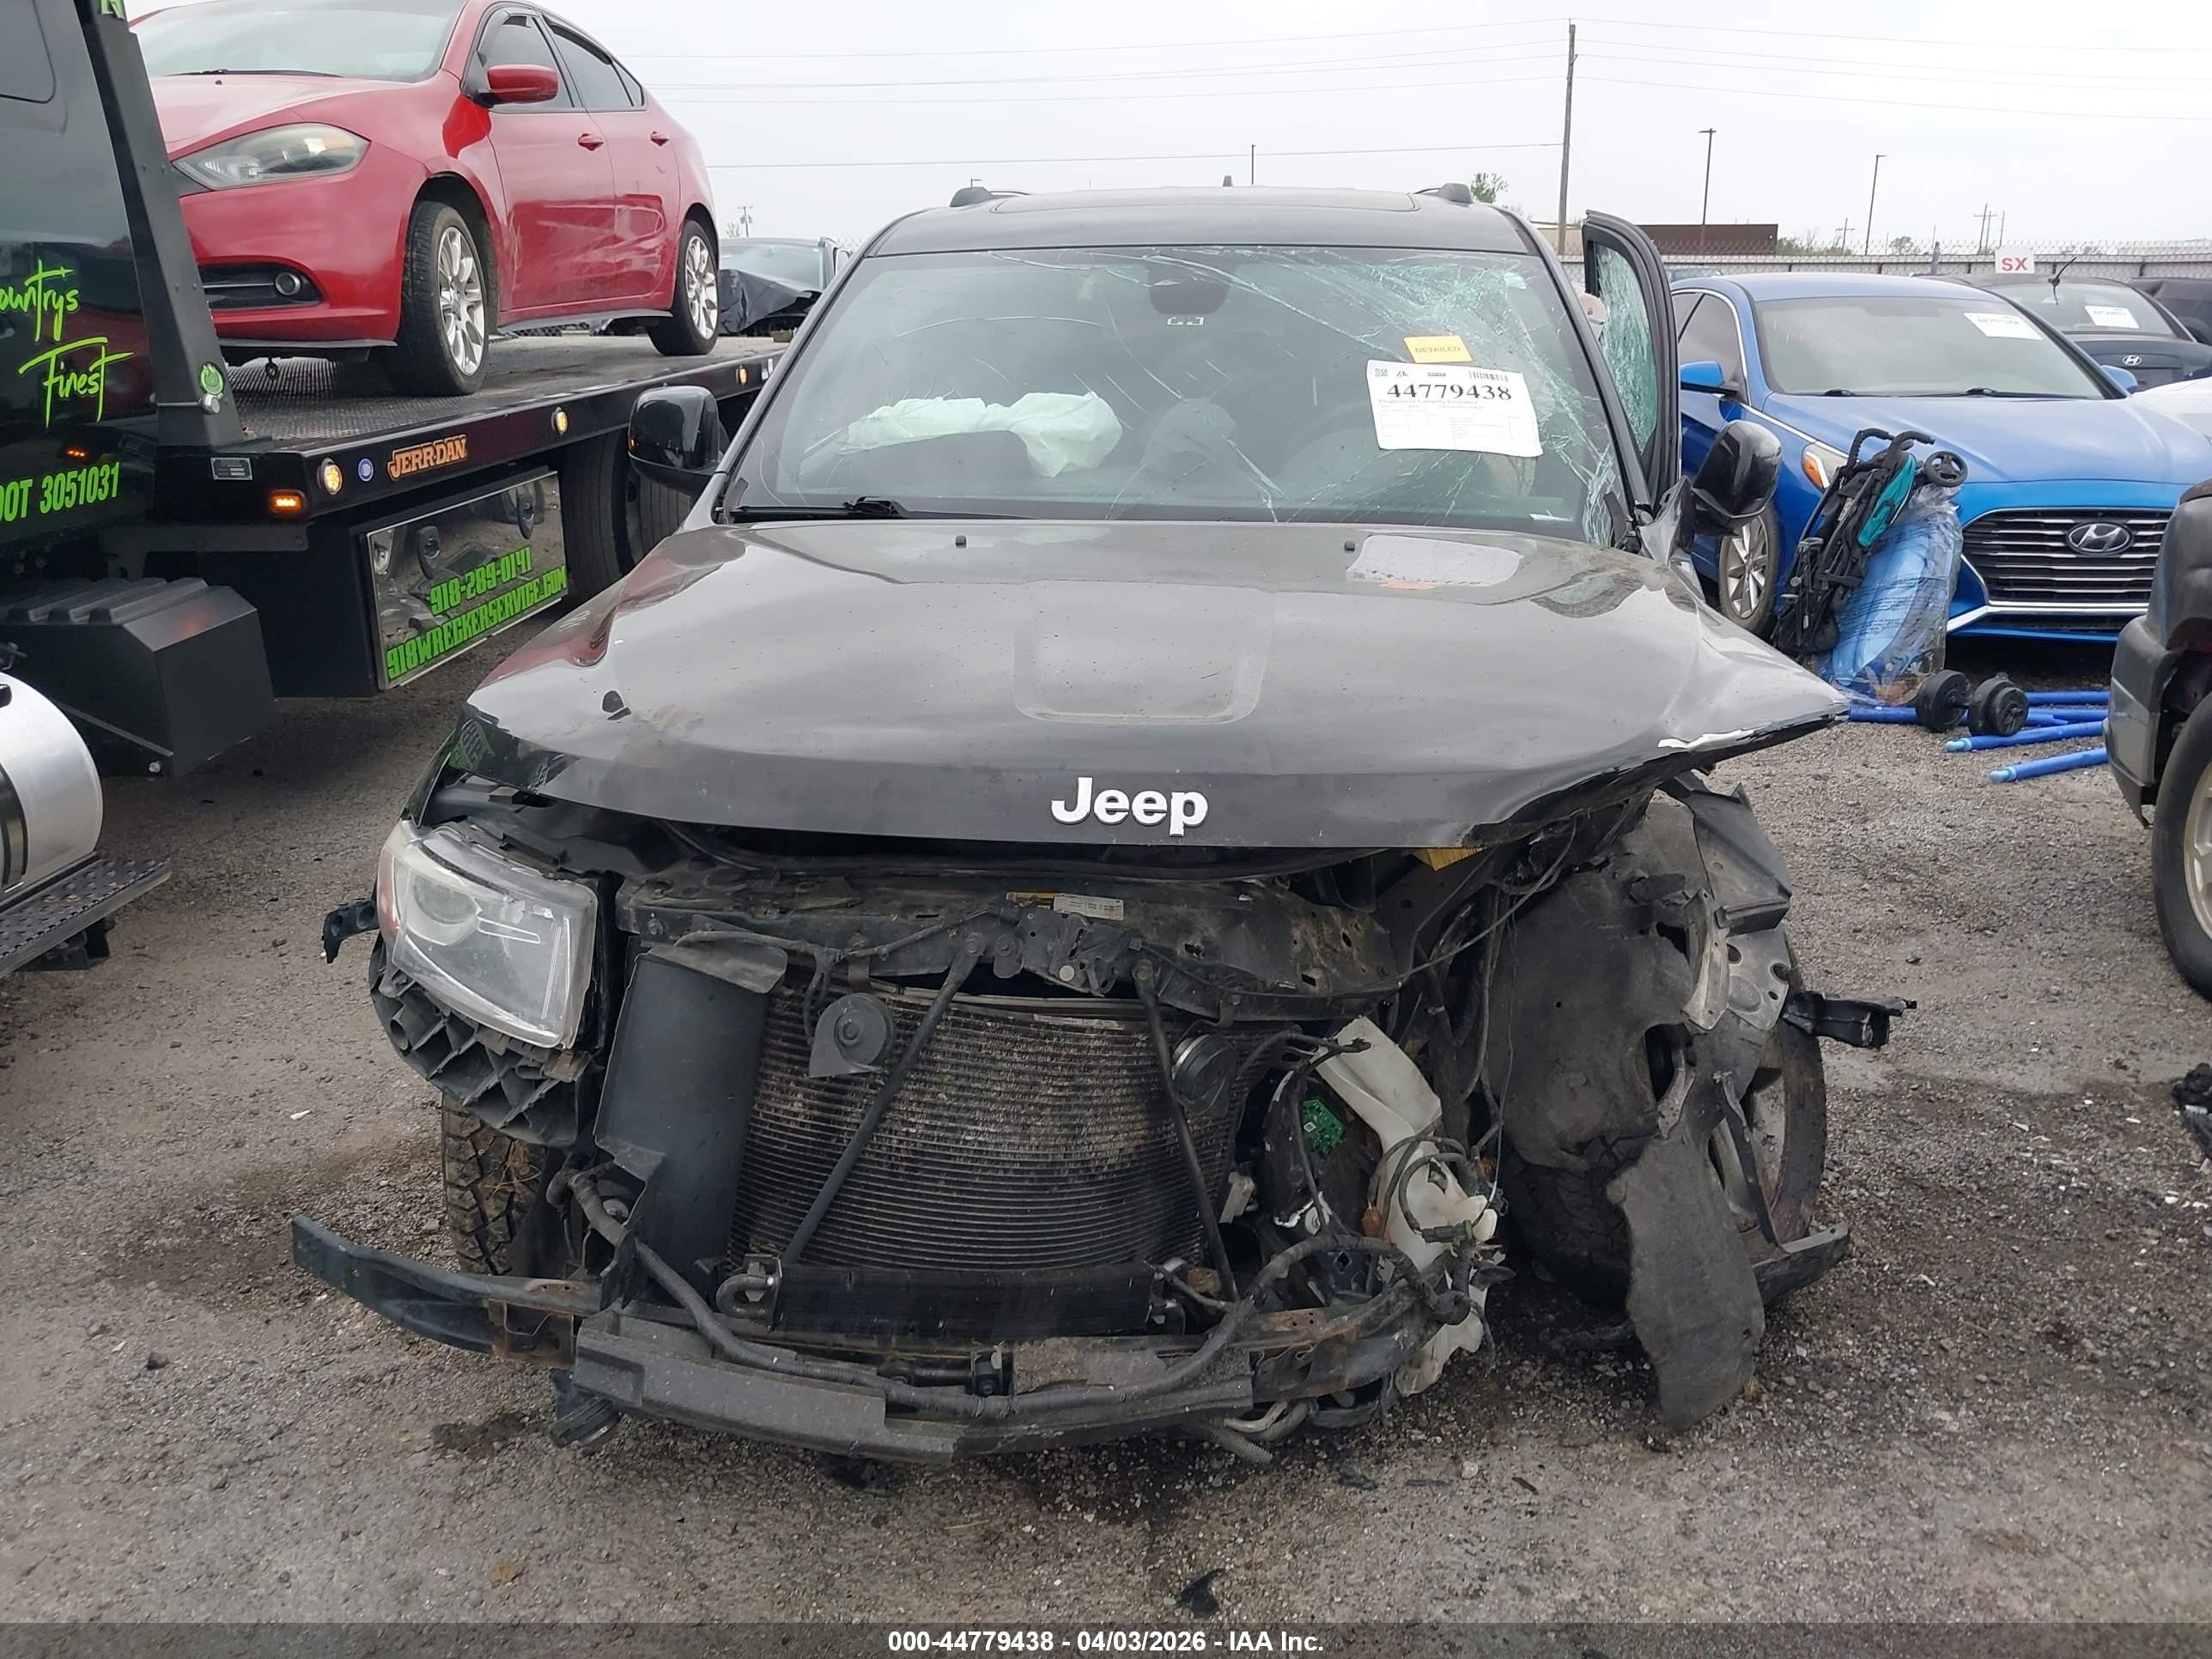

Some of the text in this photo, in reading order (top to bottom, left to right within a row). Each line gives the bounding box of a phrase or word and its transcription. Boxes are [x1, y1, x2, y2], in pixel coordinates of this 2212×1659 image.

[2002, 257, 2028, 271] SX
[1414, 345, 1462, 354] DETAILED
[17, 336, 135, 428] Finest
[1388, 384, 1513, 400] 44779438
[40, 461, 120, 514] 3051031
[429, 547, 532, 617] 918-289-0141
[386, 565, 568, 680] 918WRECKERSERVICE.COM
[1050, 776, 1209, 837] Jeep
